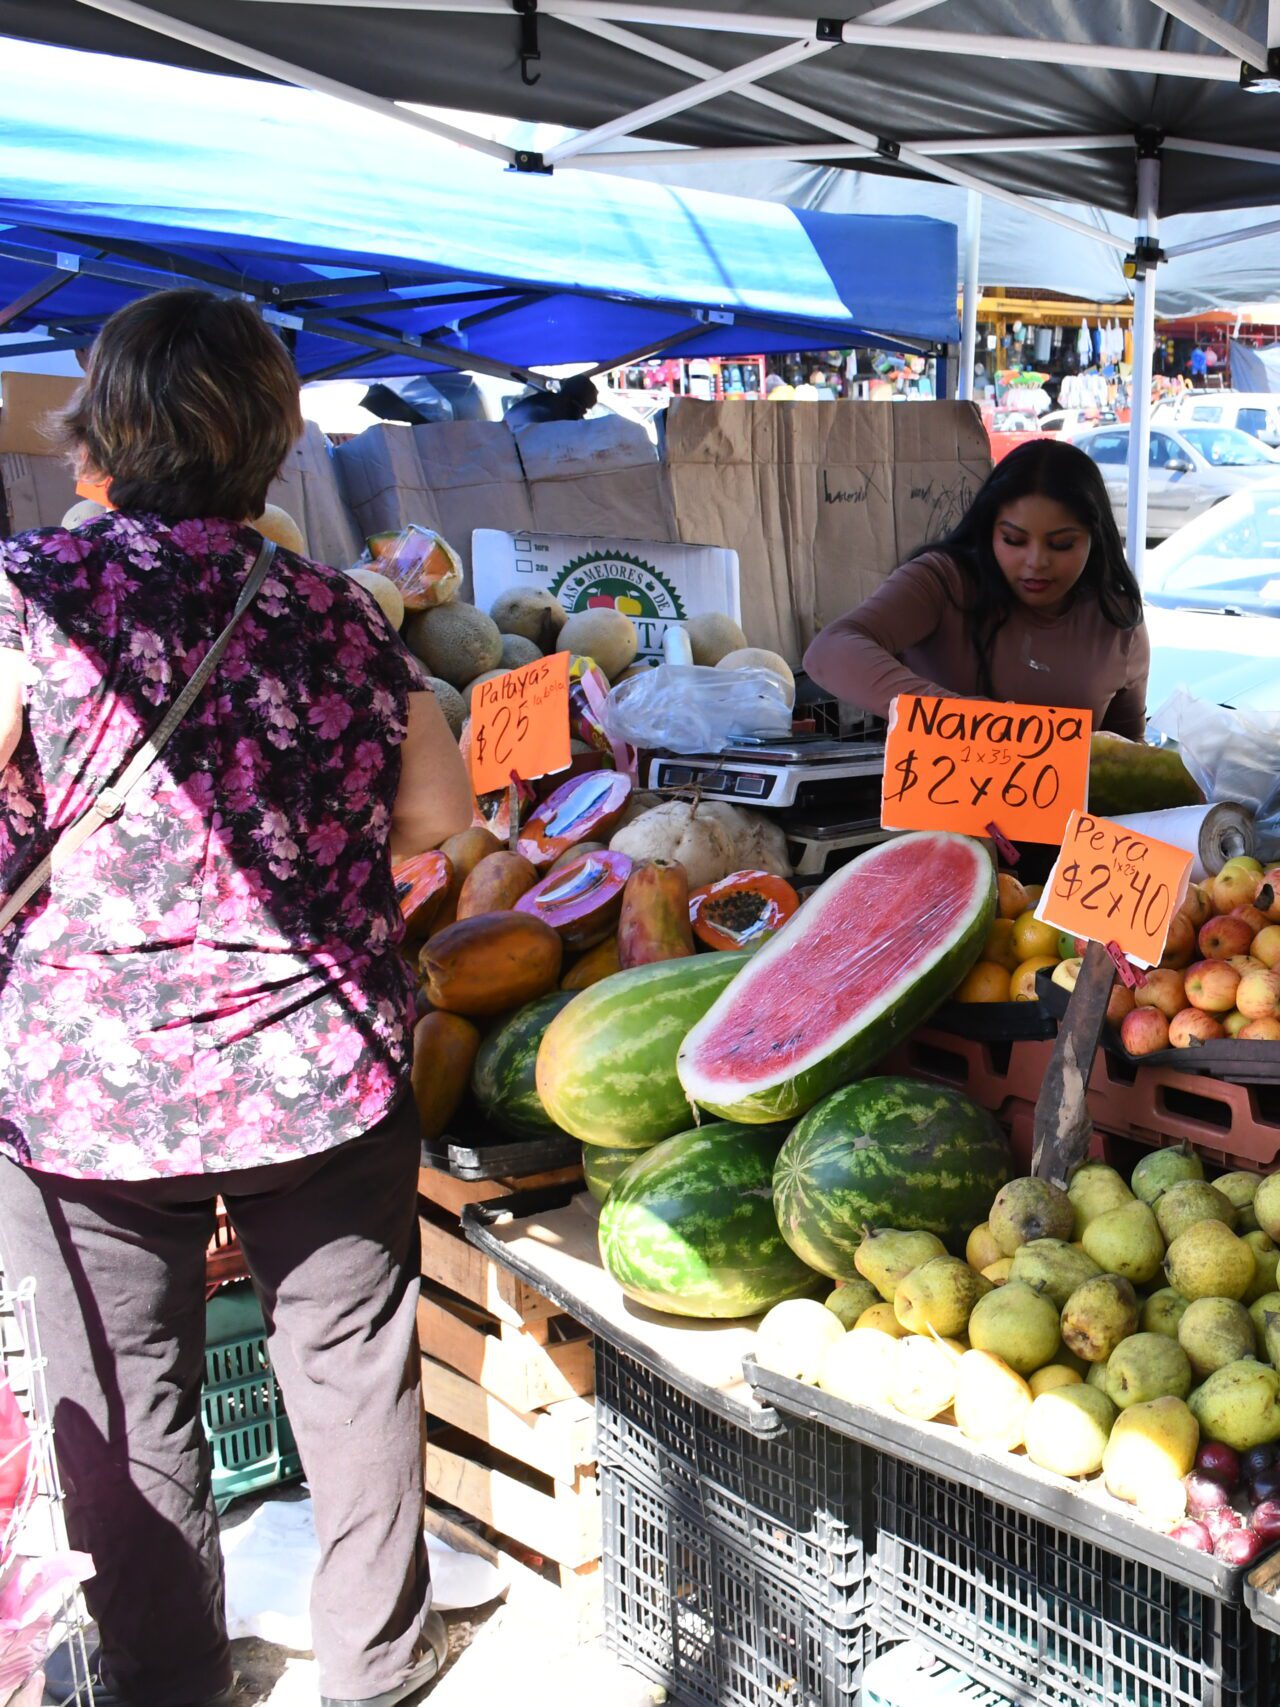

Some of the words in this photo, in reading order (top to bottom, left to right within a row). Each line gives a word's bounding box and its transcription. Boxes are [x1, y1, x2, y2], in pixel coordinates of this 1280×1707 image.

[562, 584, 579, 611] LAS
[583, 563, 644, 585] MEJORES
[653, 592, 671, 612] DE
[907, 697, 1083, 760] Naranja
[1074, 816, 1149, 862] Pera
